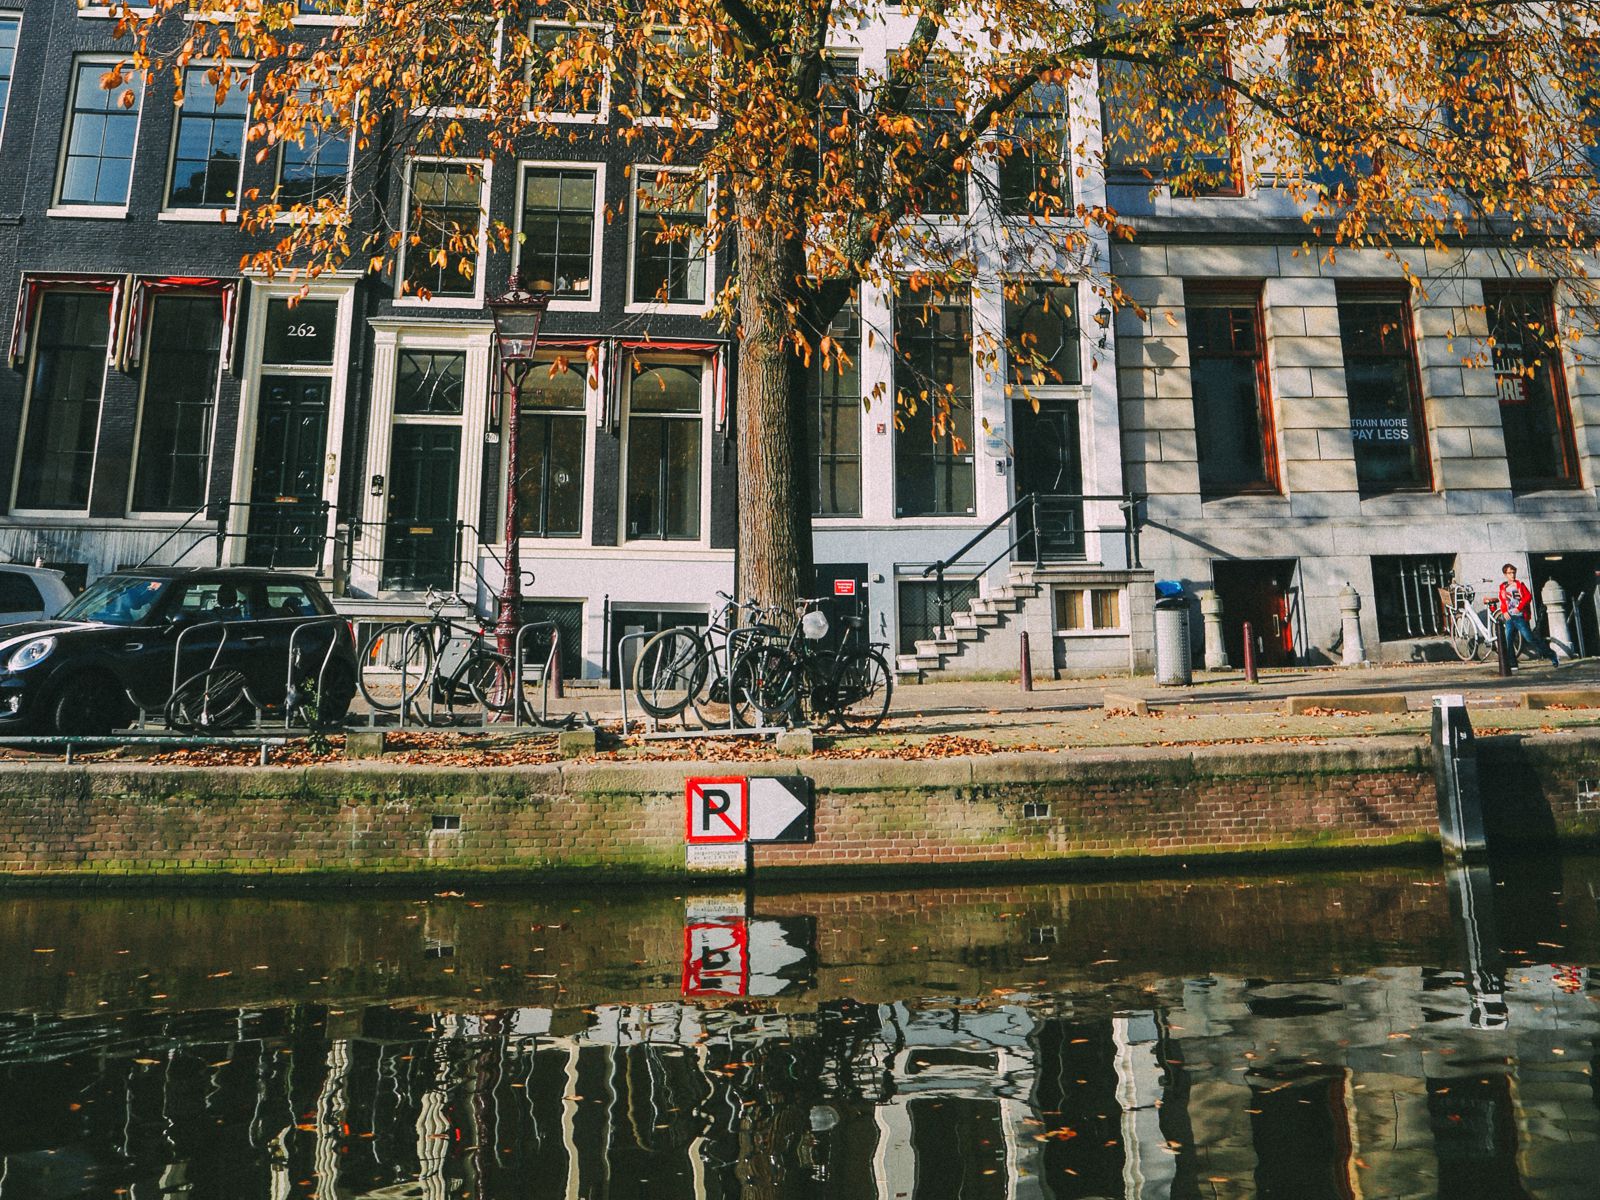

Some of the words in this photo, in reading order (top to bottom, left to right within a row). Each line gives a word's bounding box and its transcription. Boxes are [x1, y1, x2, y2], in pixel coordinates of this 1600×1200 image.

[287, 323, 317, 337] 262
[1350, 418, 1378, 428] TRAIN
[1379, 418, 1408, 428] MORE
[1351, 429, 1374, 440] PAY
[1377, 428, 1409, 440] LESS
[703, 789, 731, 831] P
